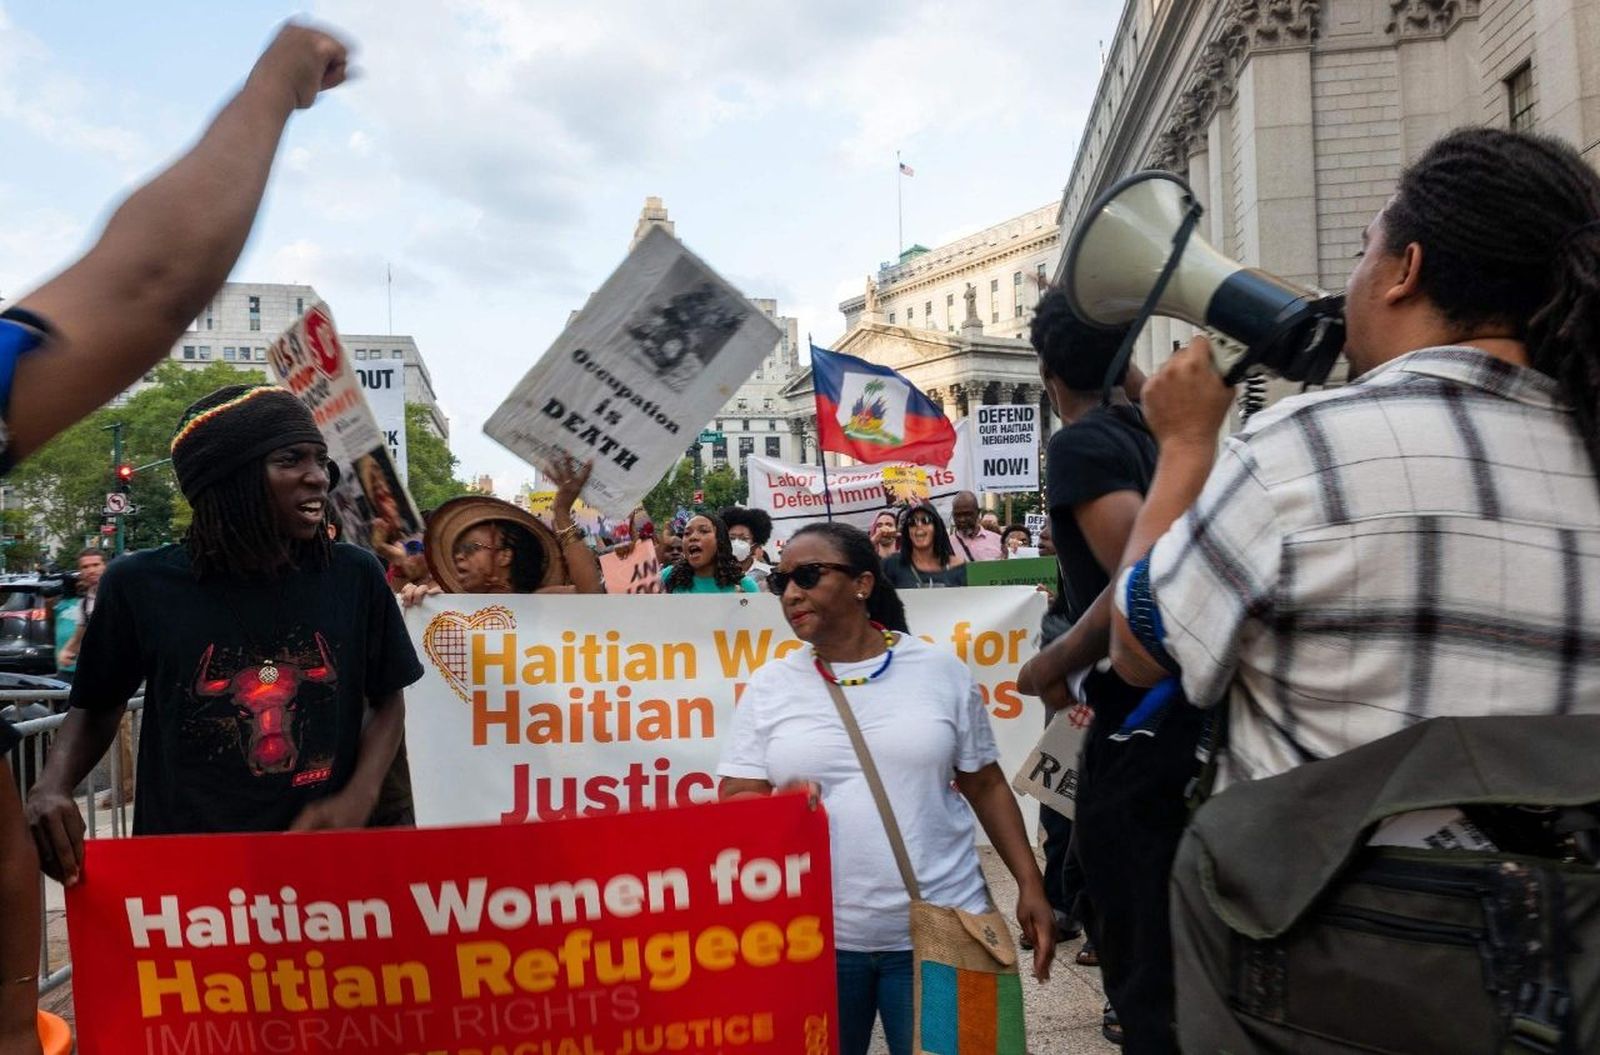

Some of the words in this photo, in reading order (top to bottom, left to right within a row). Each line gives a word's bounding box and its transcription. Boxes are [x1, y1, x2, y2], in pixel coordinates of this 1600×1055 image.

[573, 349, 681, 434] Occupation
[592, 398, 622, 426] is
[978, 407, 1034, 424] DEFEND
[541, 397, 640, 471] DEATH
[979, 425, 998, 434] OUR
[1000, 423, 1034, 433] HAITIAN
[982, 433, 1032, 446] NEIGHBORS
[767, 472, 817, 489] Labor
[983, 458, 1029, 477] NOW!
[773, 490, 834, 509] Defend
[472, 630, 697, 686] Haitian
[951, 621, 1029, 666] for
[472, 685, 715, 746] Haitian
[500, 757, 735, 824] Justic
[125, 885, 393, 949] Haitian
[409, 866, 690, 936] Women
[710, 847, 812, 905] for
[137, 950, 432, 1019] Haitian
[456, 914, 825, 999] Refugees
[145, 1009, 434, 1055] IMMIGRANT
[453, 984, 640, 1038] RIGHTS
[616, 1011, 774, 1055] JUSTICE
